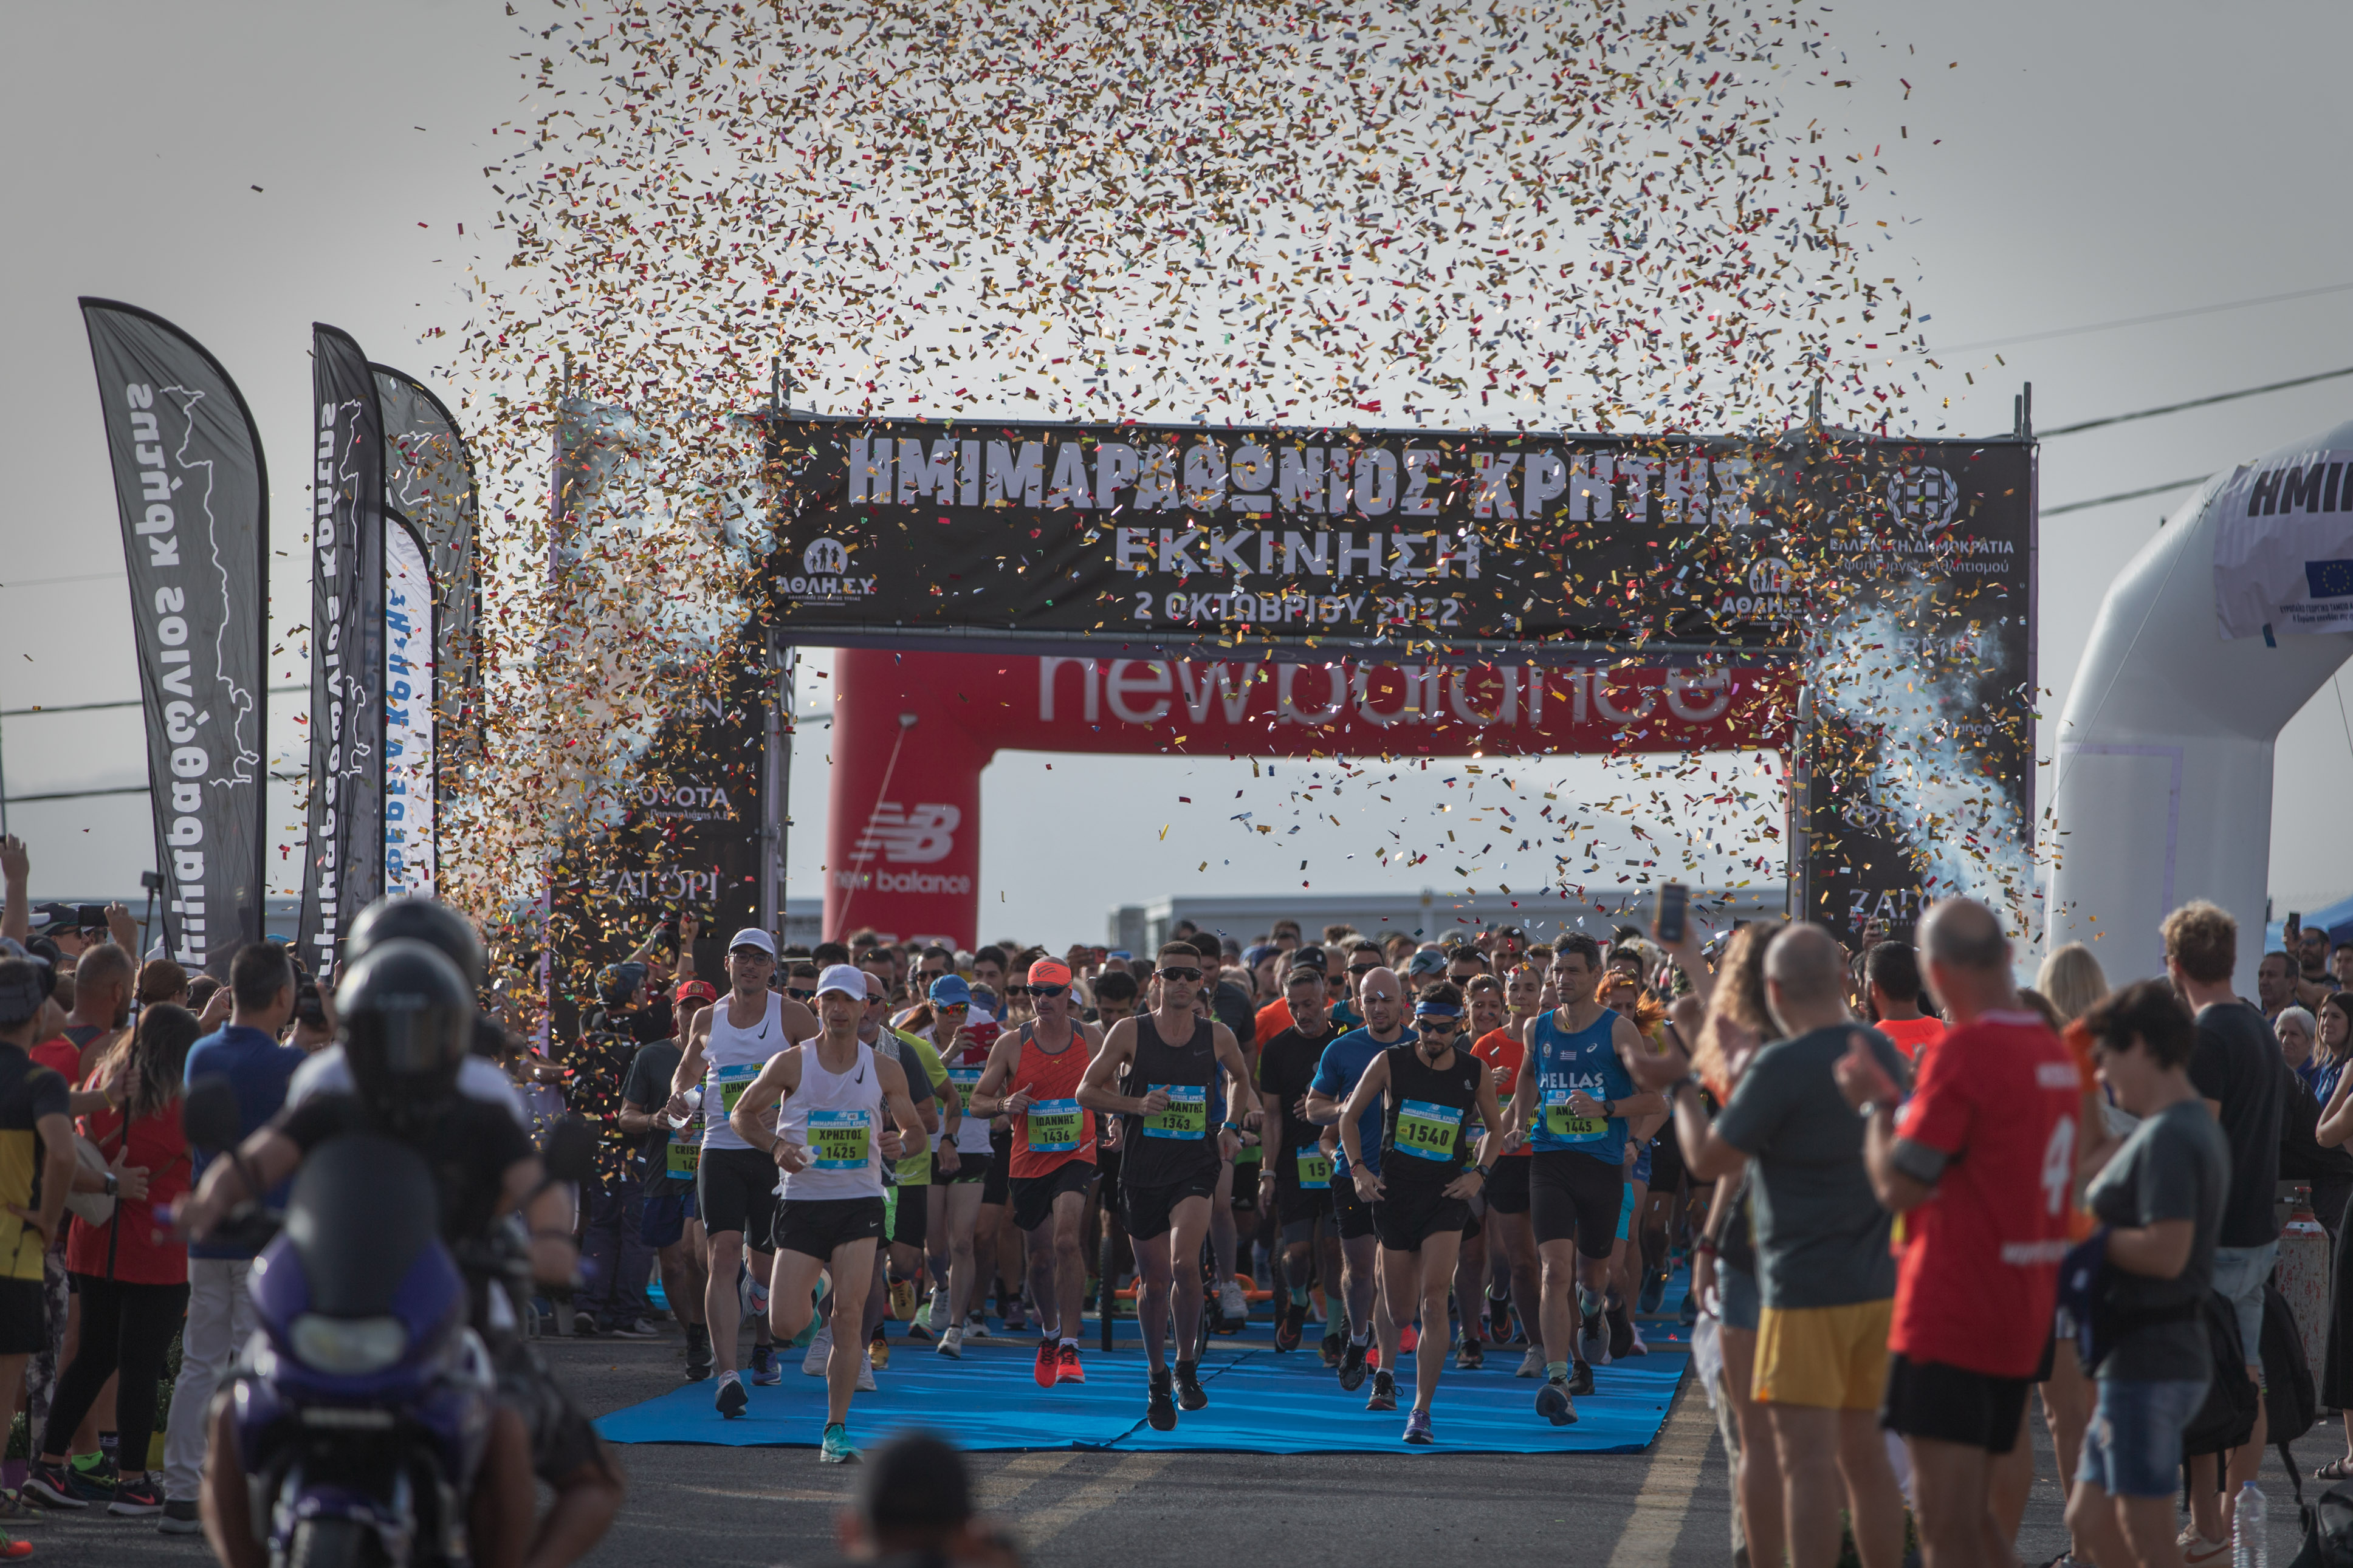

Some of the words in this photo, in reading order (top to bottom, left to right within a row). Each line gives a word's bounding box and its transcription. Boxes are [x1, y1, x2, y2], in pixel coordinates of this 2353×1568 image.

[2247, 462, 2353, 518] ΗΜΙ
[1116, 527, 1480, 579] ΕΚΚΙΝΗΣΗ
[1133, 591, 1153, 620] 2
[1165, 592, 1365, 625] ΟΚΤΩΒΡΙΟΥ
[1376, 598, 1460, 627] 2022
[1039, 655, 1263, 725] new
[1277, 663, 1732, 727] balance
[634, 786, 731, 807] OYOTA
[876, 868, 971, 895] balance
[1539, 1072, 1604, 1089] HELLAS
[1036, 1115, 1075, 1126] ΙΩΑΝΝΗΣ
[1163, 1117, 1190, 1130] 1343
[1565, 1121, 1592, 1133] 1445
[819, 1129, 862, 1140] ΧΡΗΣΤΟΣ
[1043, 1130, 1070, 1143] 1436
[1409, 1123, 1449, 1146] 1540
[826, 1146, 856, 1159] 1425
[2041, 1113, 2075, 1216] 4
